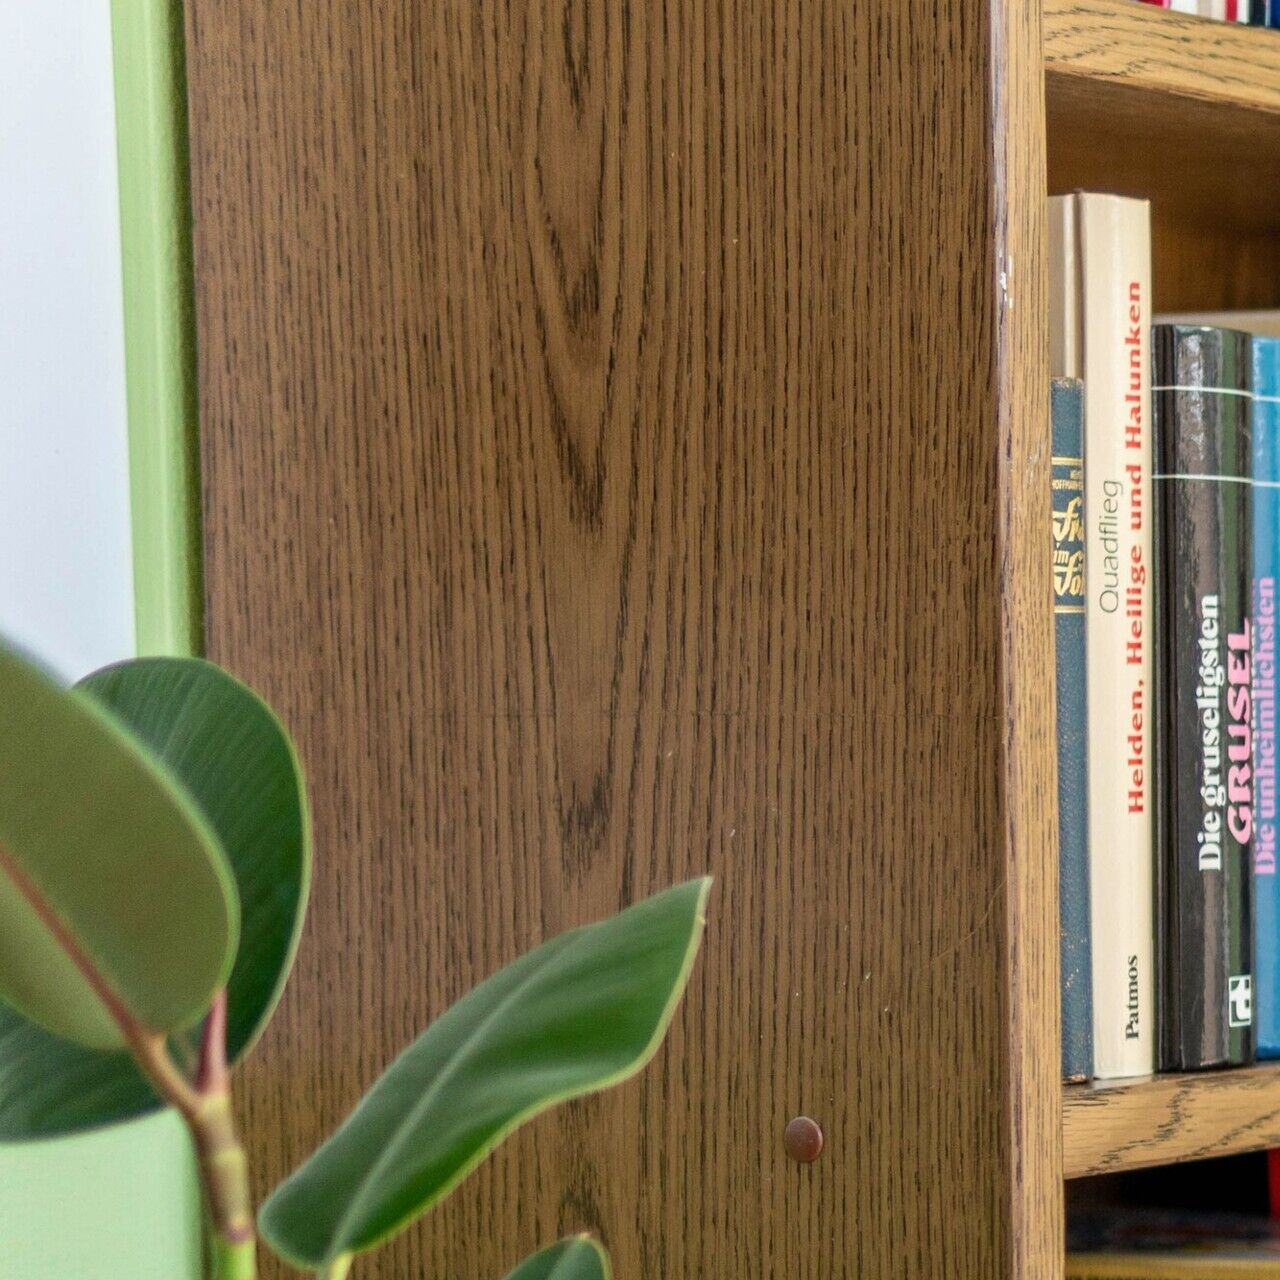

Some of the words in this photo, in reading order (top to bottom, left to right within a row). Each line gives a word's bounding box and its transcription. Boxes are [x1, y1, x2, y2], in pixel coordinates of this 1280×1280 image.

[1124, 281, 1142, 450] Halunken
[1099, 480, 1123, 614] Quadflieg
[1125, 464, 1142, 531] und
[1126, 545, 1147, 665] Heilige
[1126, 679, 1145, 814] Helden,
[1196, 595, 1226, 807] gruseligsten
[1227, 616, 1252, 845] GRUSEL
[1252, 577, 1276, 819] unheimlichsten
[1197, 813, 1221, 871] Die
[1254, 824, 1276, 875] Die
[1125, 954, 1140, 1040] Patmos
